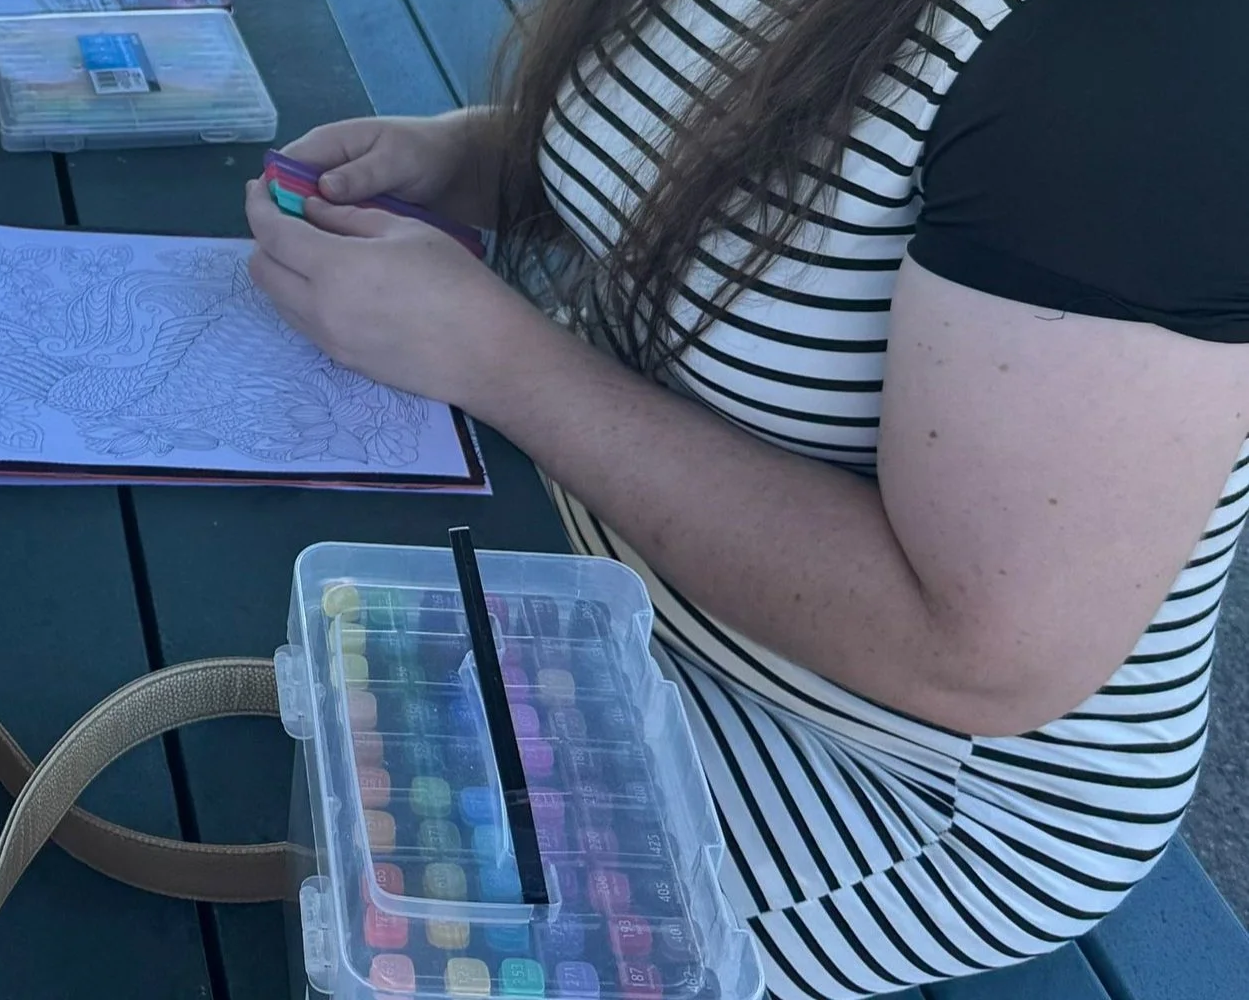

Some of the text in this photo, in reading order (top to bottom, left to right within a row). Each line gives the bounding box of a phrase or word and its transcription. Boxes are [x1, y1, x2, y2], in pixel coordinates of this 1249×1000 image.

[655, 882, 671, 903] 405
[618, 920, 635, 939] 193
[630, 967, 647, 987] 187
